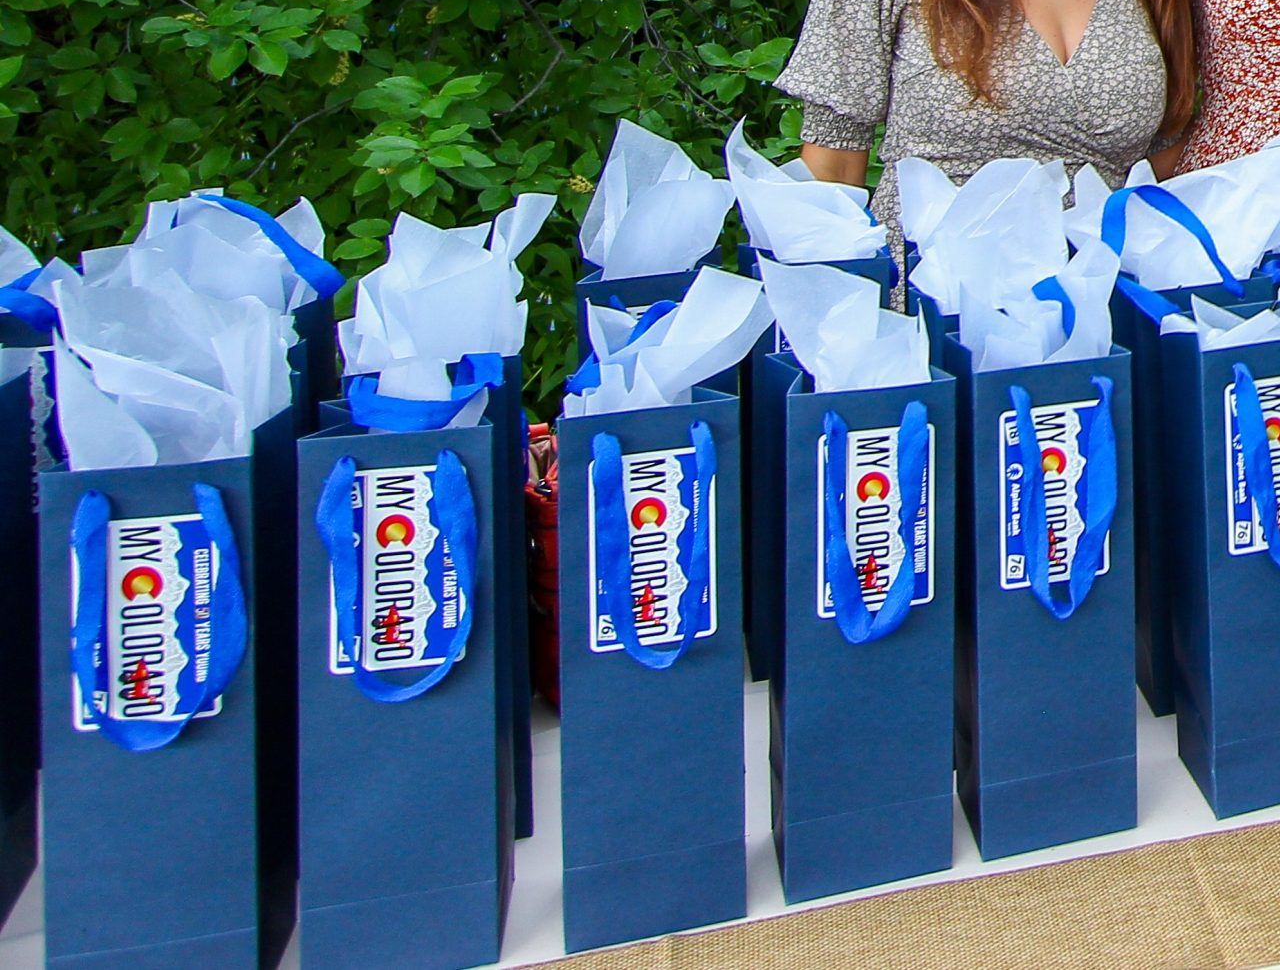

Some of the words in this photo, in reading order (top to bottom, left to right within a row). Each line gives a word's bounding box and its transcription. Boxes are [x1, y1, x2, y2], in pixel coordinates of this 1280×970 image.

[1035, 412, 1067, 444] MY
[856, 436, 891, 468] MY
[629, 458, 667, 493] MY
[375, 475, 417, 512] MY
[1010, 483, 1022, 511] Alpine
[1236, 481, 1249, 503] Bank
[914, 520, 928, 546] YEARS
[1010, 512, 1022, 536] Bank
[1237, 522, 1250, 539] 76
[119, 525, 163, 563] MY
[914, 547, 927, 574] YOUNG
[1009, 557, 1022, 574] 76
[194, 548, 209, 605] CELEBRATING
[374, 514, 417, 663] COLORADO
[442, 569, 459, 598] YEARS
[442, 599, 458, 629] YOUNG
[119, 565, 165, 718] COLORADO
[195, 621, 212, 651] YEARS
